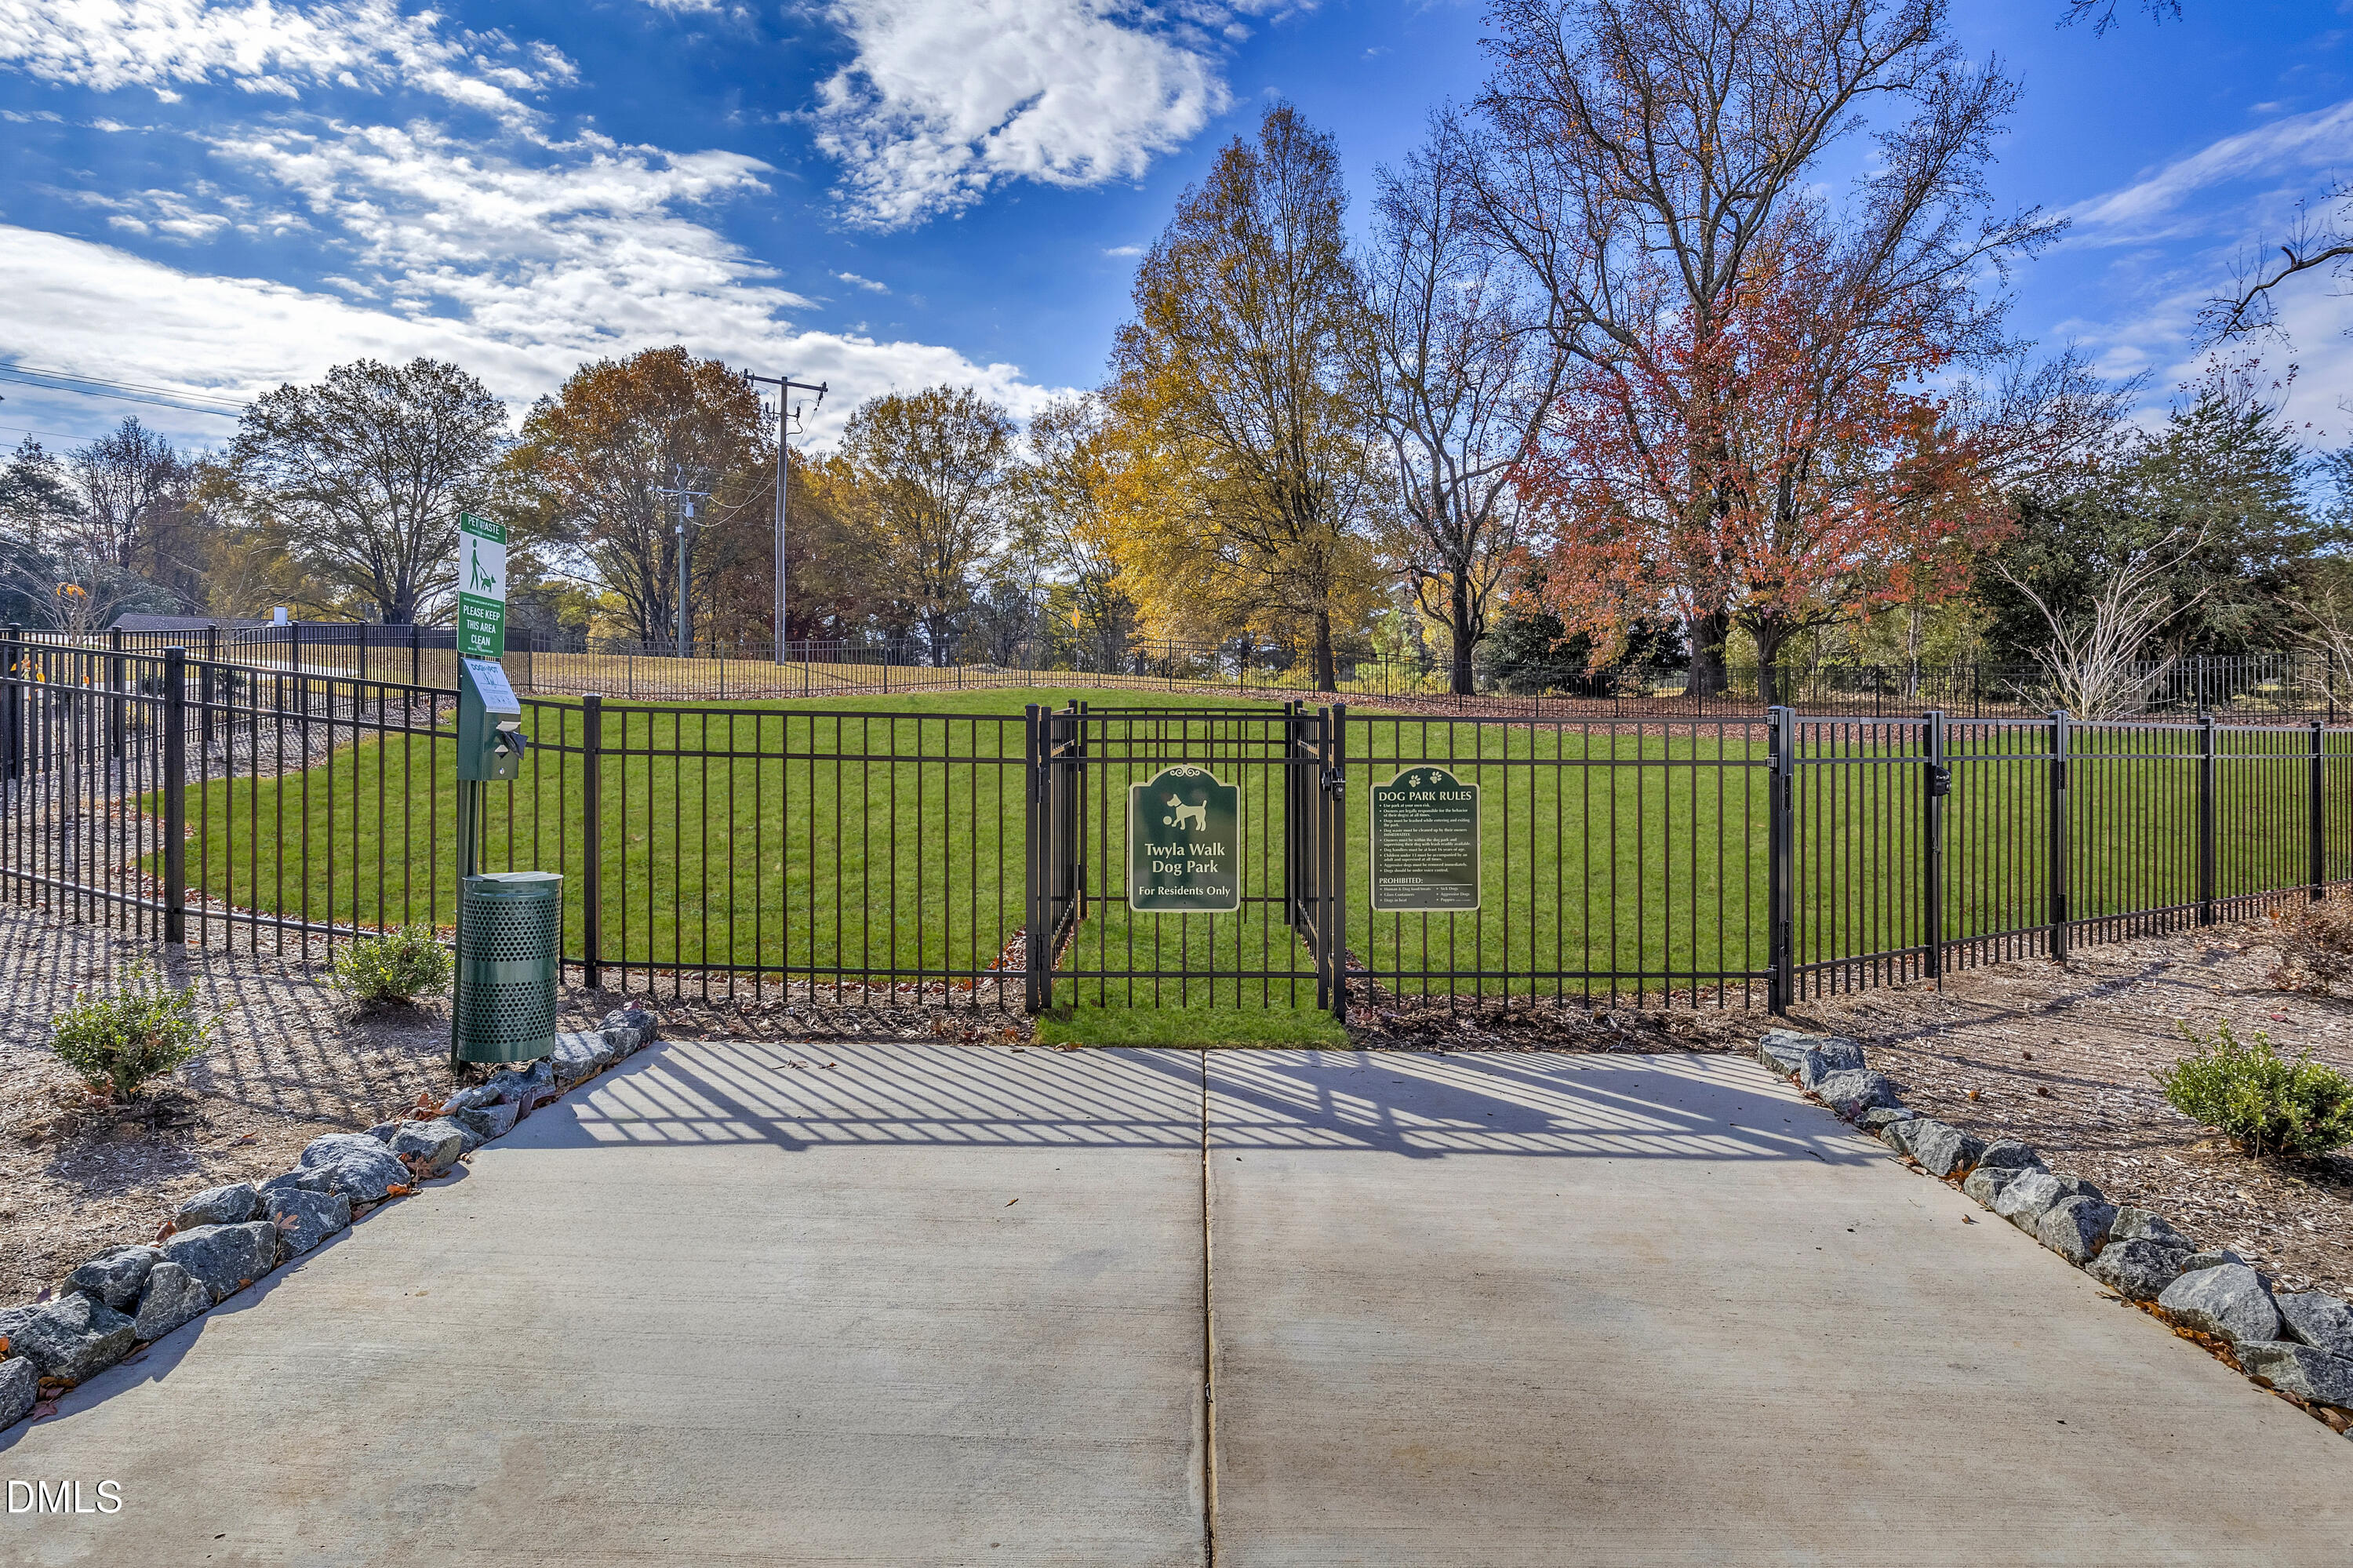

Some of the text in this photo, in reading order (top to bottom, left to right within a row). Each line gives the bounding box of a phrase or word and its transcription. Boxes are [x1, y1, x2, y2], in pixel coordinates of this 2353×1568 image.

[468, 516, 479, 527] PET
[480, 520, 500, 535] WASTE
[463, 605, 500, 621] PLEASE KEEP
[466, 619, 496, 634] THIS AREA
[471, 634, 490, 646] CLEAN
[1379, 791, 1472, 801] DOG PARK RULES
[1144, 842, 1225, 859] Twyla Walk
[1152, 860, 1218, 876] Dog Park
[1139, 886, 1230, 897] For Residents Only
